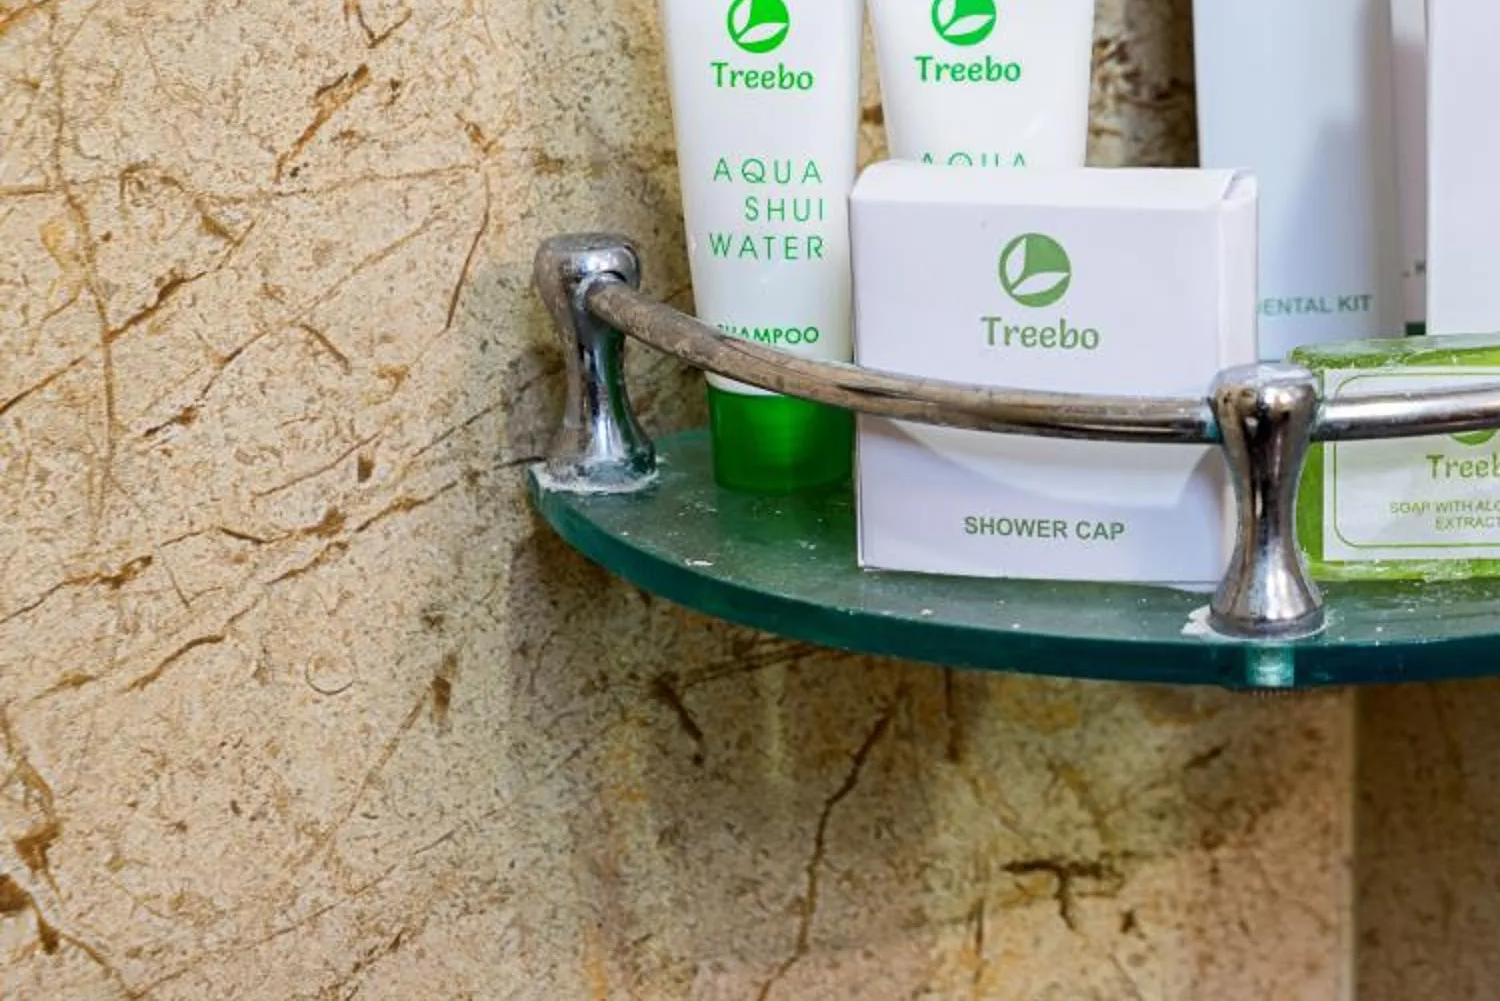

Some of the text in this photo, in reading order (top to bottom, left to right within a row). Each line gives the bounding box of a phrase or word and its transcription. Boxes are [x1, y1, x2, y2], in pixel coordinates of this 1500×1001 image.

[710, 61, 814, 91] Treebo
[914, 54, 1021, 83] Treebo
[713, 156, 822, 185] AQUA
[743, 196, 823, 222] SHUI
[709, 232, 823, 260] WATER
[1257, 294, 1372, 316] ENTAL KIT
[717, 324, 819, 344] AMPOO
[980, 316, 1099, 350] Treebo
[1435, 501, 1472, 512] WITH
[964, 516, 1125, 541] SHOWER CAP
